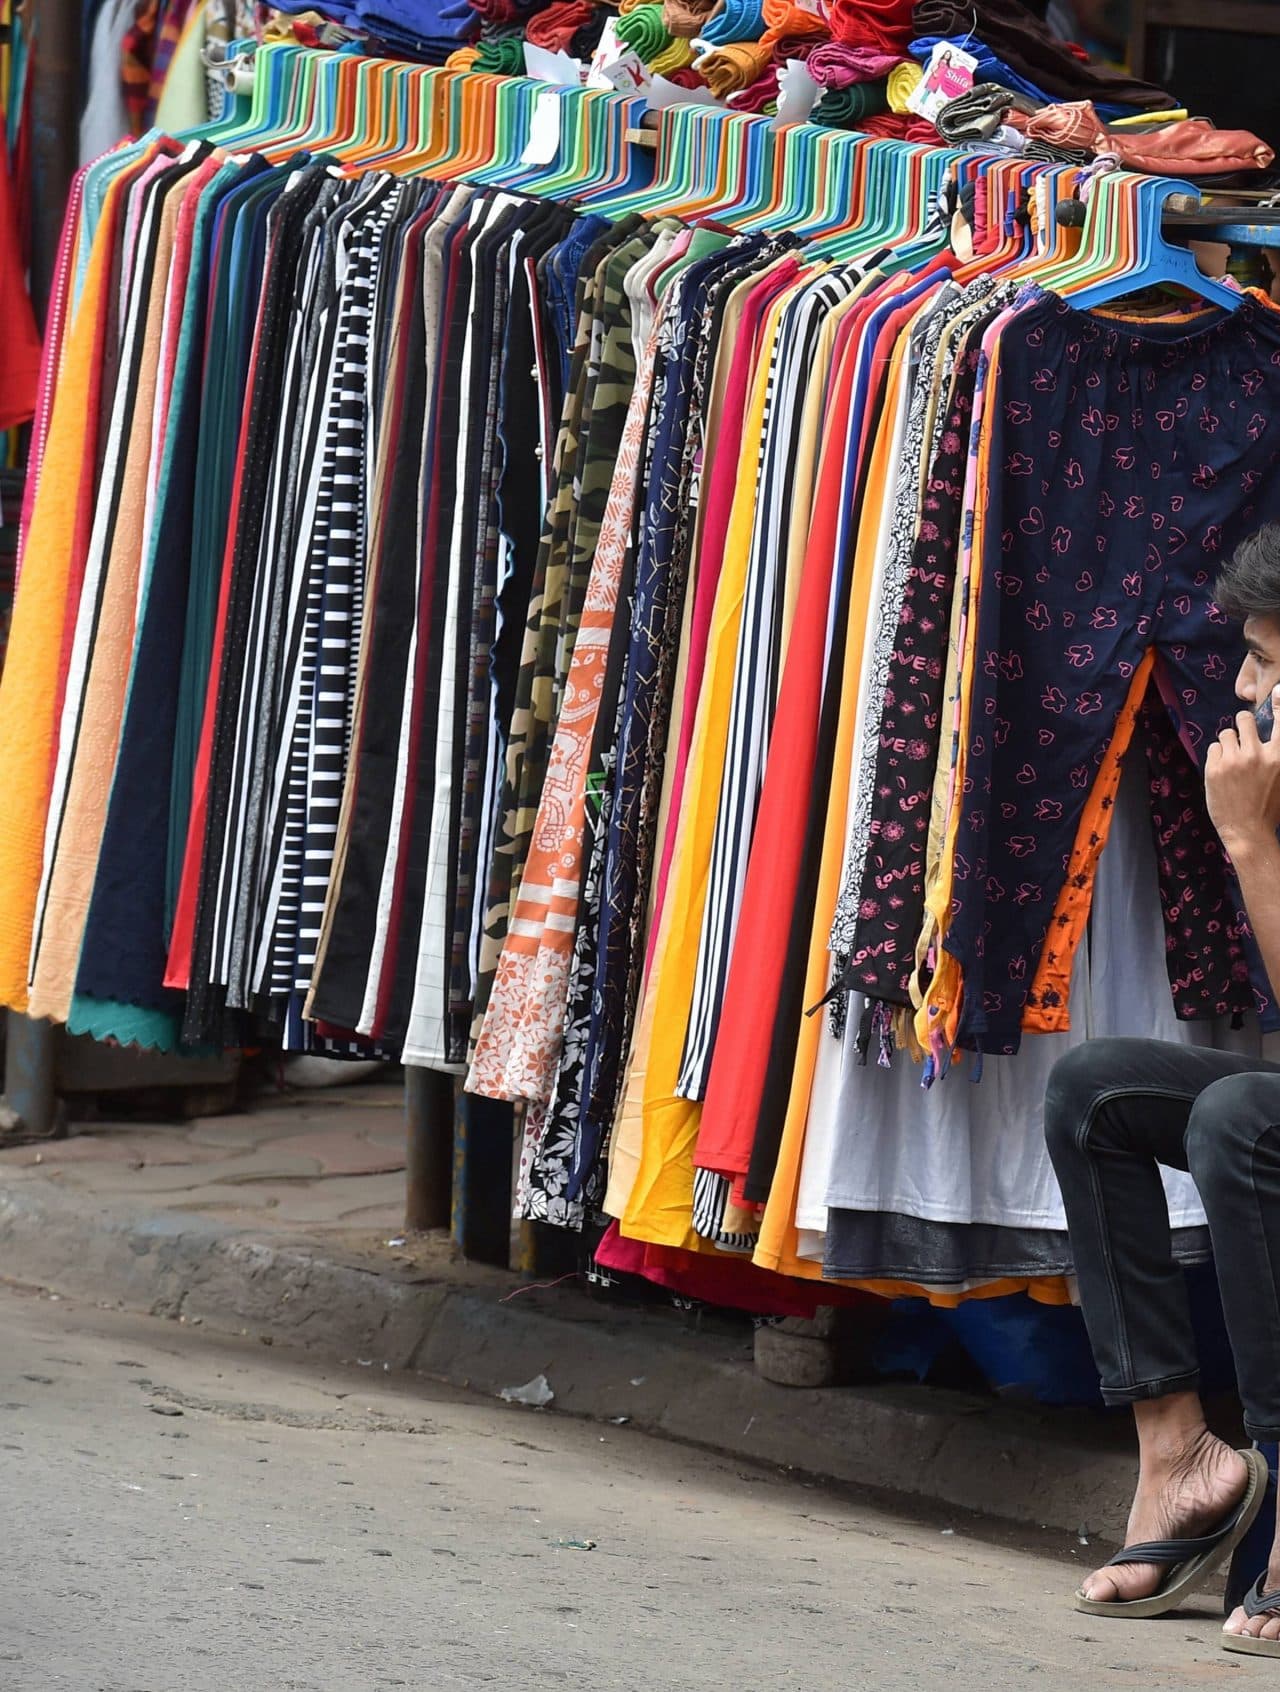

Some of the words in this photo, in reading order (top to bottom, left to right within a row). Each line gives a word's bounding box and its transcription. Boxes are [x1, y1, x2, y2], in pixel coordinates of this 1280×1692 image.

[945, 69, 969, 88] Shifa
[927, 478, 961, 500] LOVE
[909, 567, 946, 588] OVE
[890, 650, 926, 670] OVE
[874, 861, 921, 890] LOVE
[1171, 967, 1205, 993] OVE
